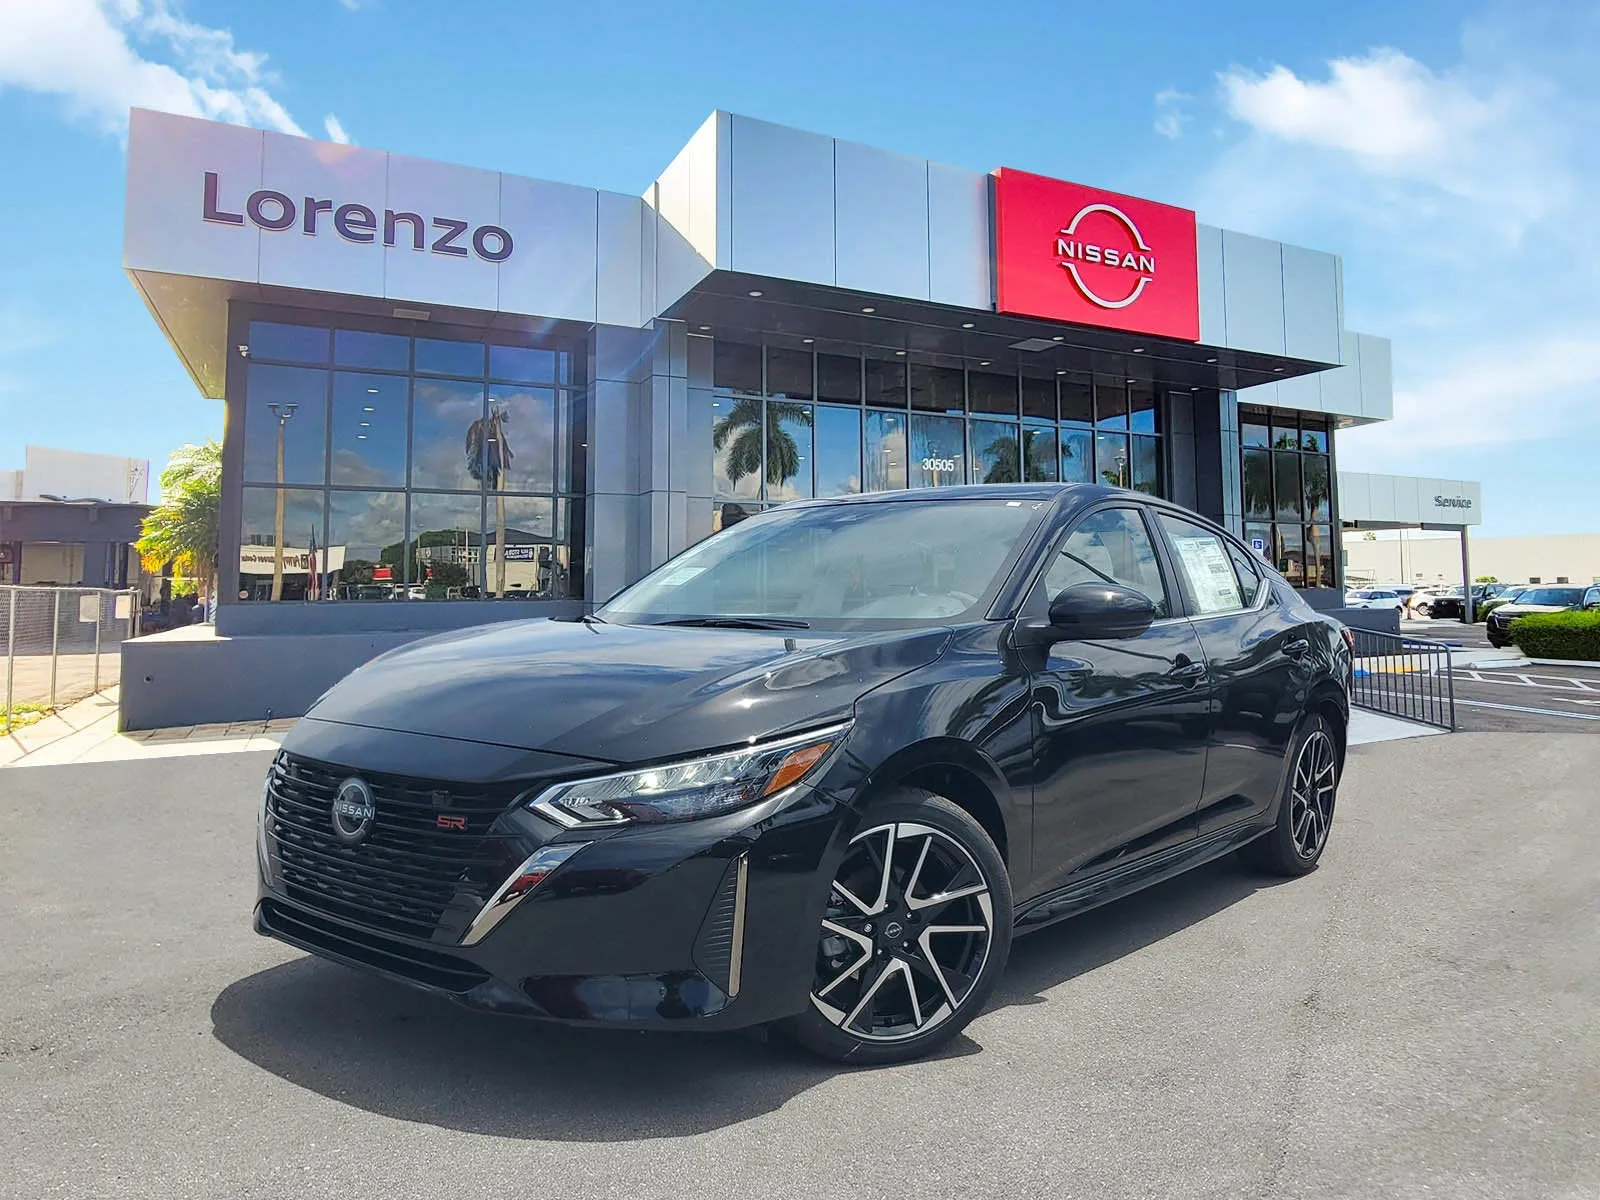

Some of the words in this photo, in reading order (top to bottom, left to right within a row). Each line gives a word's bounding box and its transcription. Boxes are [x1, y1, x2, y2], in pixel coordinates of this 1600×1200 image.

[203, 171, 514, 262] Lorenzo
[1057, 238, 1155, 273] NISSAN
[922, 458, 954, 471] 30505
[1433, 495, 1472, 509] Service
[333, 799, 376, 820] NISSAN
[437, 815, 465, 830] SR
